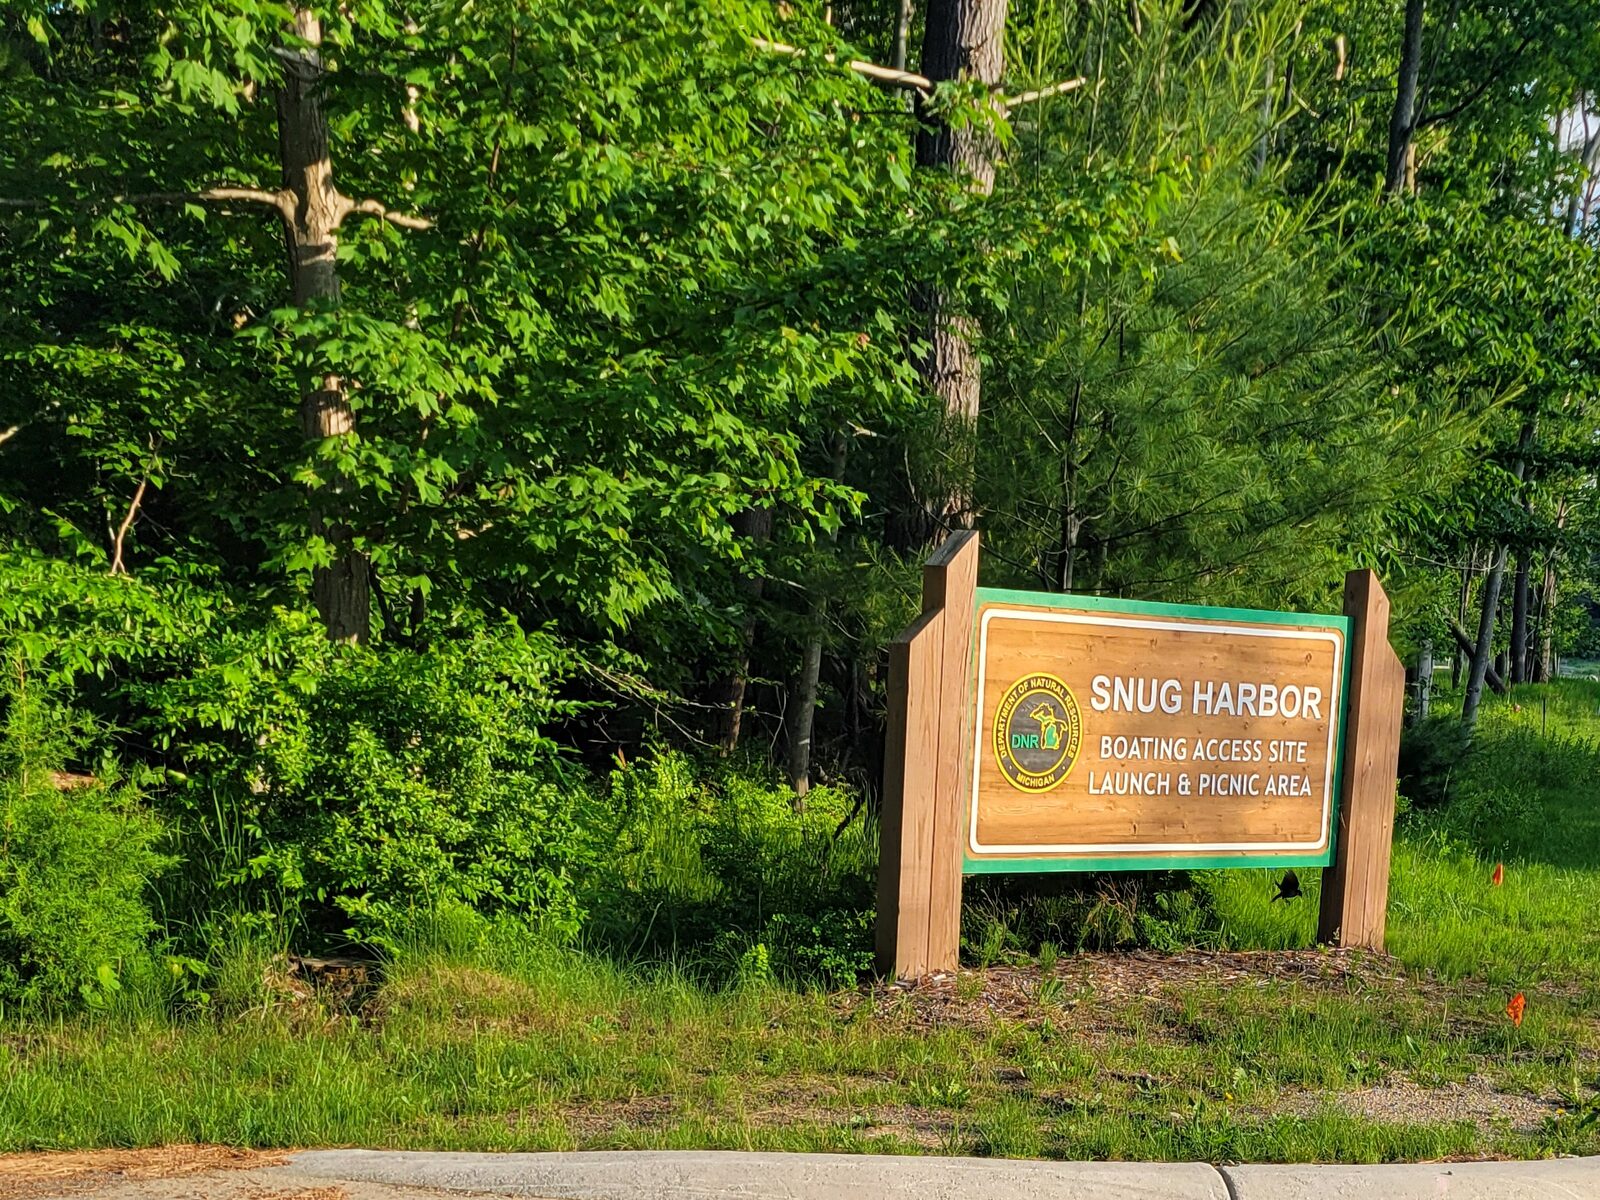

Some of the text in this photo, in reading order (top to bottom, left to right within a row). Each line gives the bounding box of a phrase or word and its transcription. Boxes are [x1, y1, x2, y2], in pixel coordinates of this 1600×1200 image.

[1090, 675, 1322, 719] SNUG HARBOR
[997, 678, 1079, 759] DEPARTMENT OF NATURAL RESOURCES
[1011, 734, 1039, 749] DNR
[1100, 736, 1308, 763] BOATING ACCESS SITE
[1016, 773, 1055, 787] MICHIGAN
[1088, 771, 1312, 796] LAUNCH & PICNIC AREA
